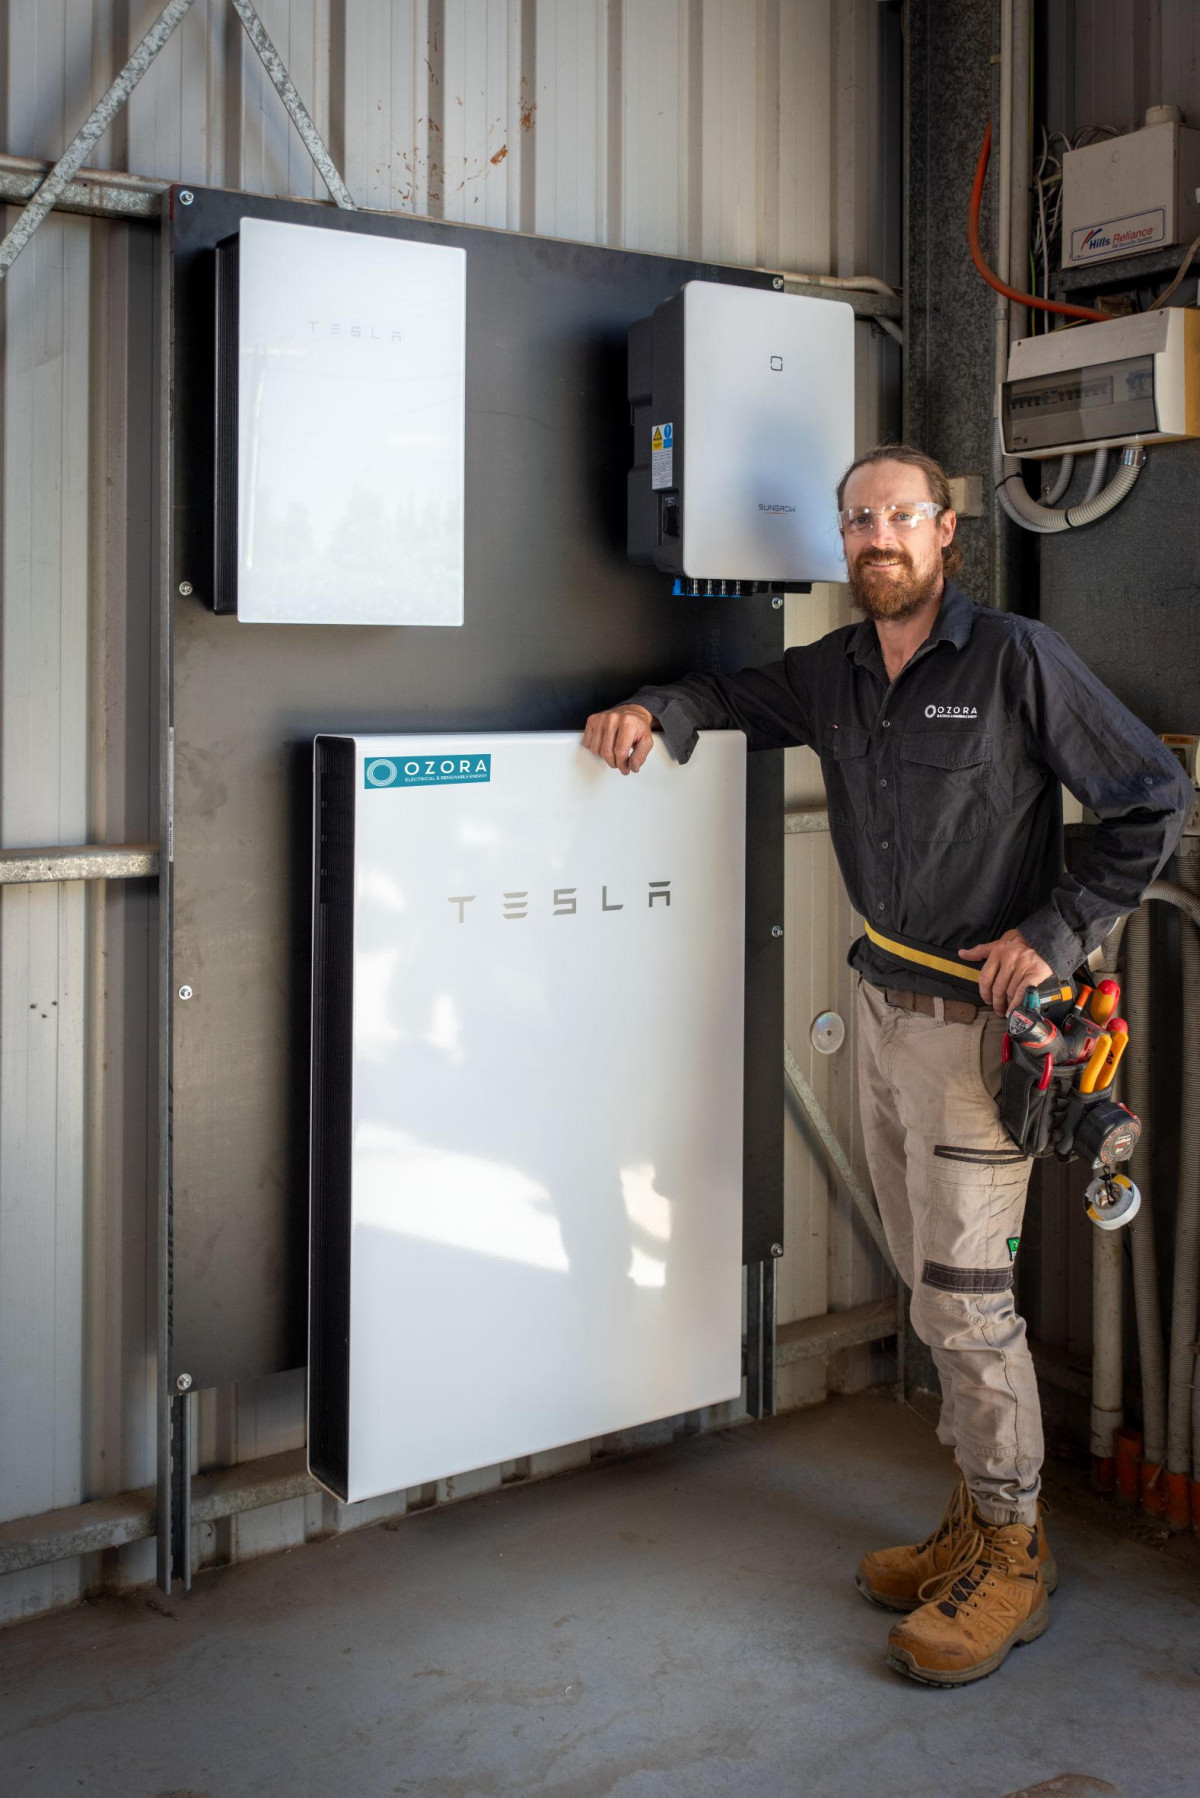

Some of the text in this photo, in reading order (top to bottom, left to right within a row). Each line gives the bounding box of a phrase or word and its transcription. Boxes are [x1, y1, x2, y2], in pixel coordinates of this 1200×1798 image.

[1089, 227, 1153, 250] Hills Reliance
[308, 320, 402, 342] TESLA
[758, 503, 796, 512] SUNGROW
[937, 706, 978, 714] OZORA
[404, 760, 487, 776] OZORA
[447, 880, 671, 924] TESLA
